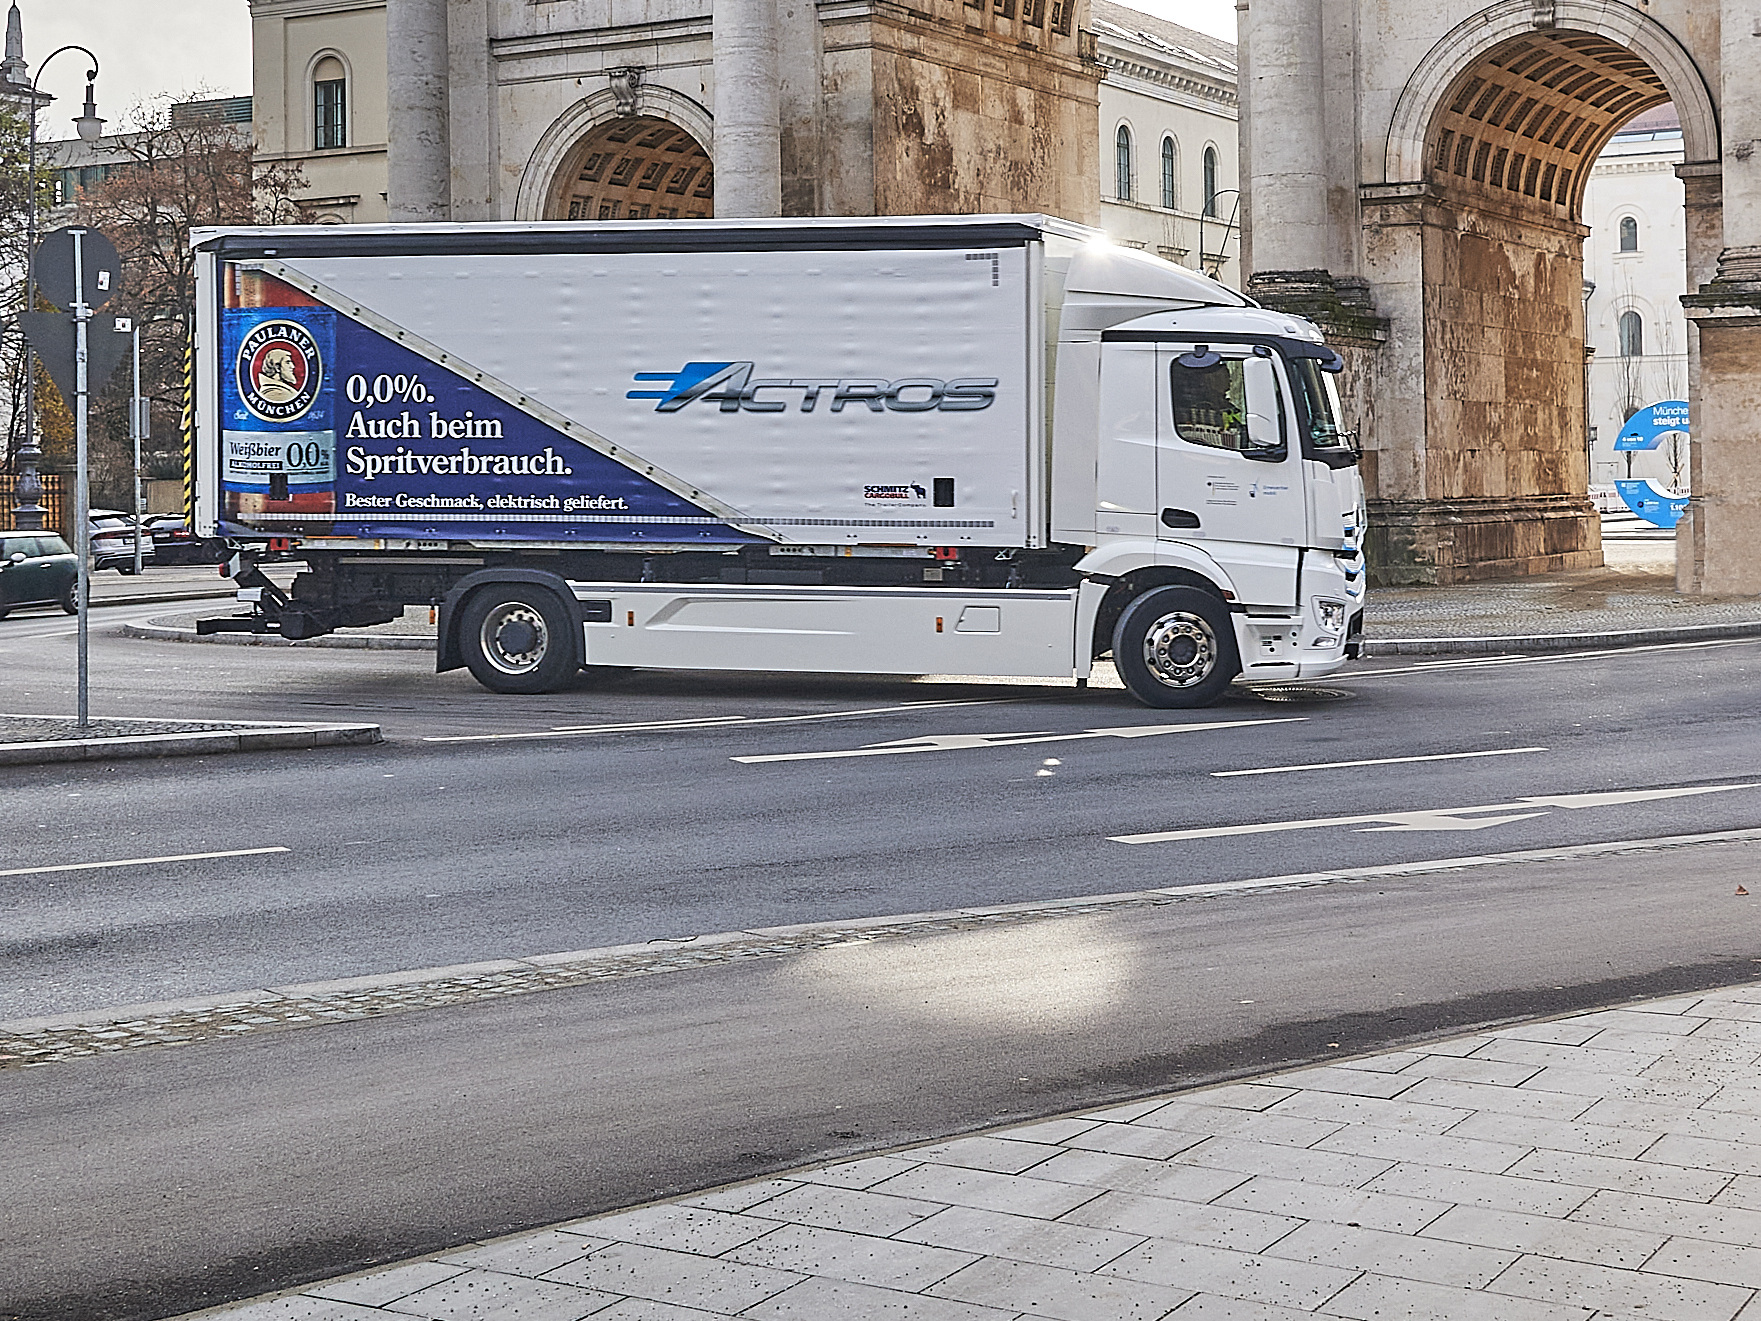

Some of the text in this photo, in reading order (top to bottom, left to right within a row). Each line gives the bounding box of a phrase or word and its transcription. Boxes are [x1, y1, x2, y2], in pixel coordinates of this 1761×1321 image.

[242, 326, 316, 361] PAULANER
[345, 374, 436, 409] 0,0%.
[655, 361, 999, 413] ACTROS
[246, 391, 311, 416] MÜNCHEN
[1653, 406, 1689, 416] Münche
[345, 410, 504, 439] Auch beim
[1652, 415, 1681, 427] steigt
[229, 441, 282, 459] Weißbier
[286, 441, 320, 468] 0,0
[345, 446, 573, 480] Spritverbrauch.
[345, 493, 629, 512] Bester Geschmack, elektrisch geliefert.
[864, 485, 909, 493] SCHMITZ
